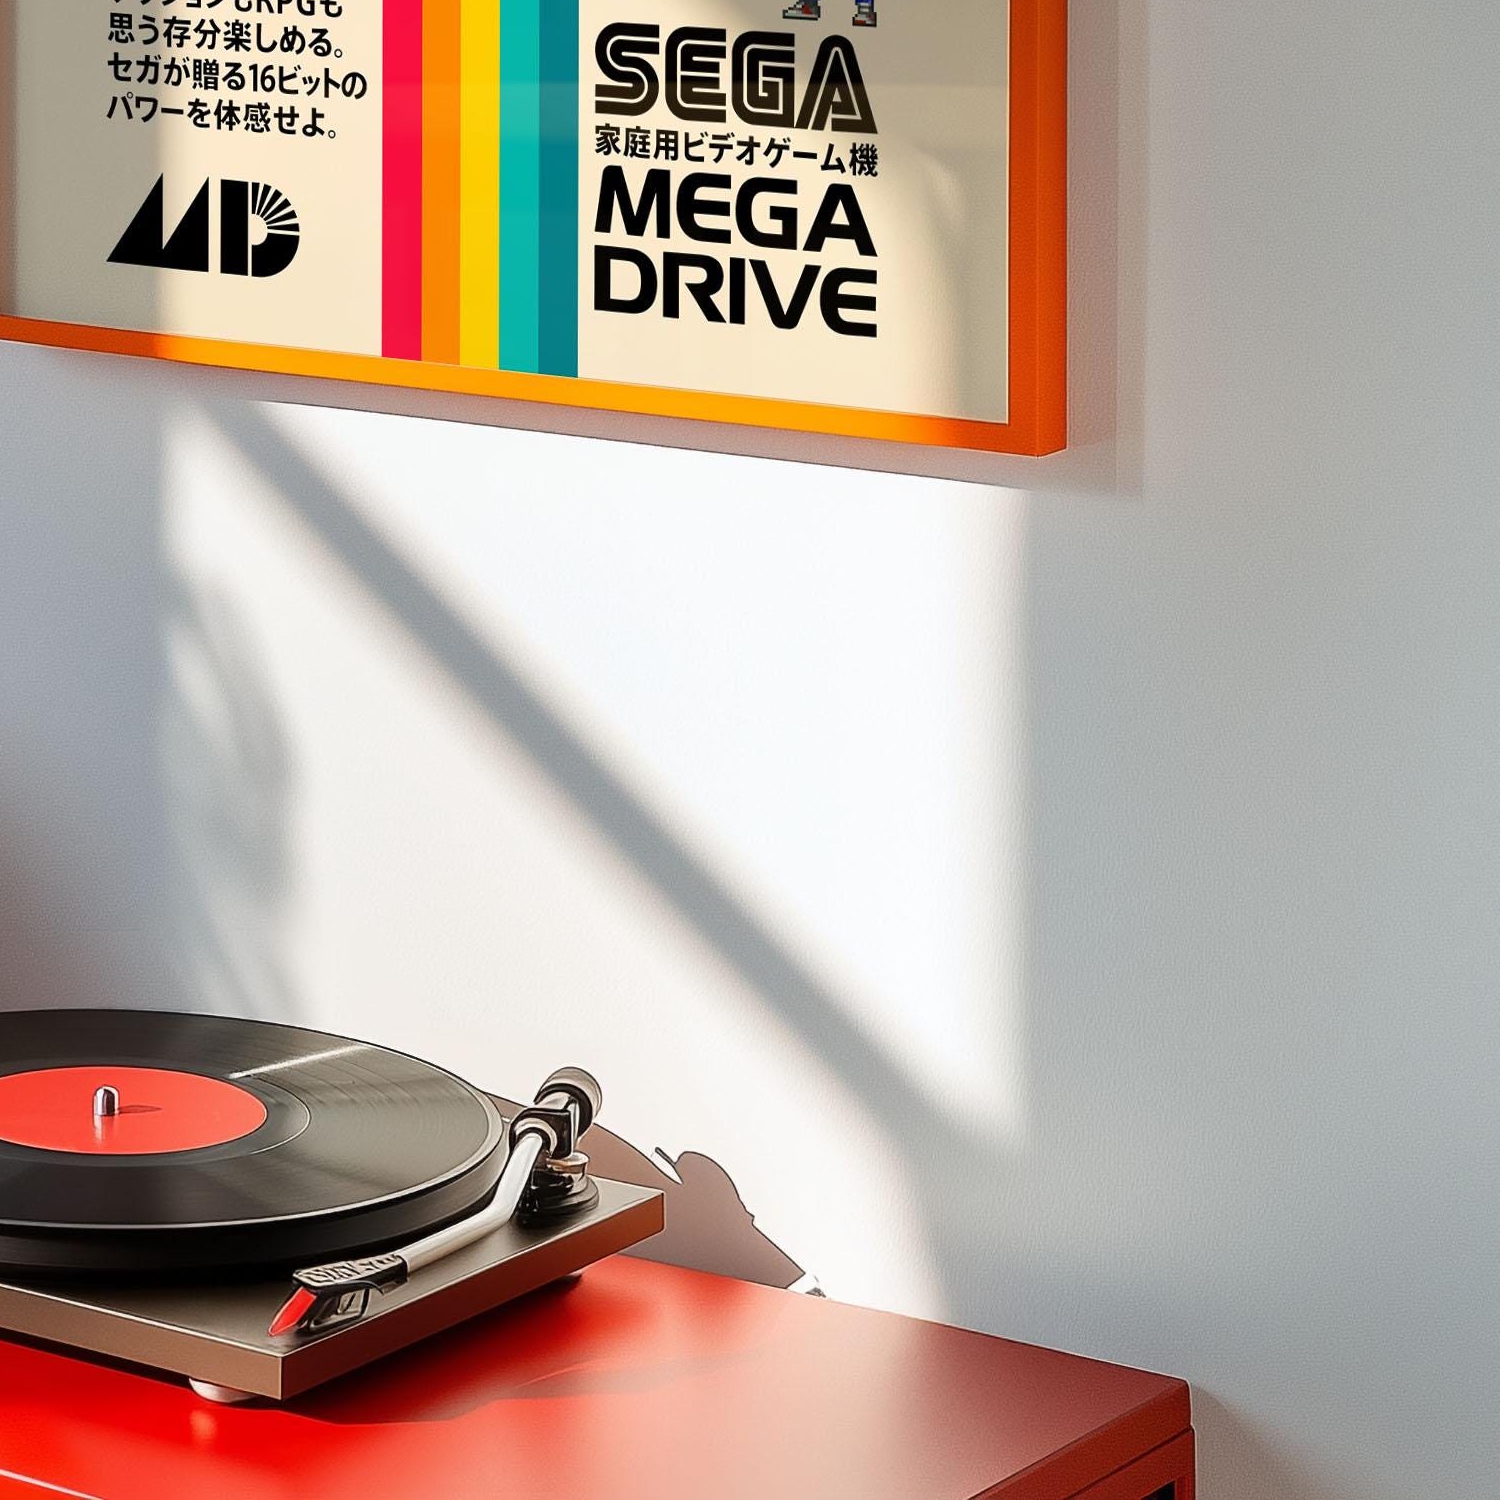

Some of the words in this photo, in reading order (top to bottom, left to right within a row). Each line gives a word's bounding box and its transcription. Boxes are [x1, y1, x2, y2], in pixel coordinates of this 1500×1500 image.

[107, 12, 343, 58] 思う存分楽しめる。
[106, 51, 367, 100] セガが贈る16ビットの
[594, 22, 878, 134] SEGA
[106, 91, 337, 139] パワーを体感せよ。
[594, 123, 878, 177] 家庭用ビデオゲーム機
[594, 165, 878, 257] MEGA
[594, 245, 878, 338] DRIVE
